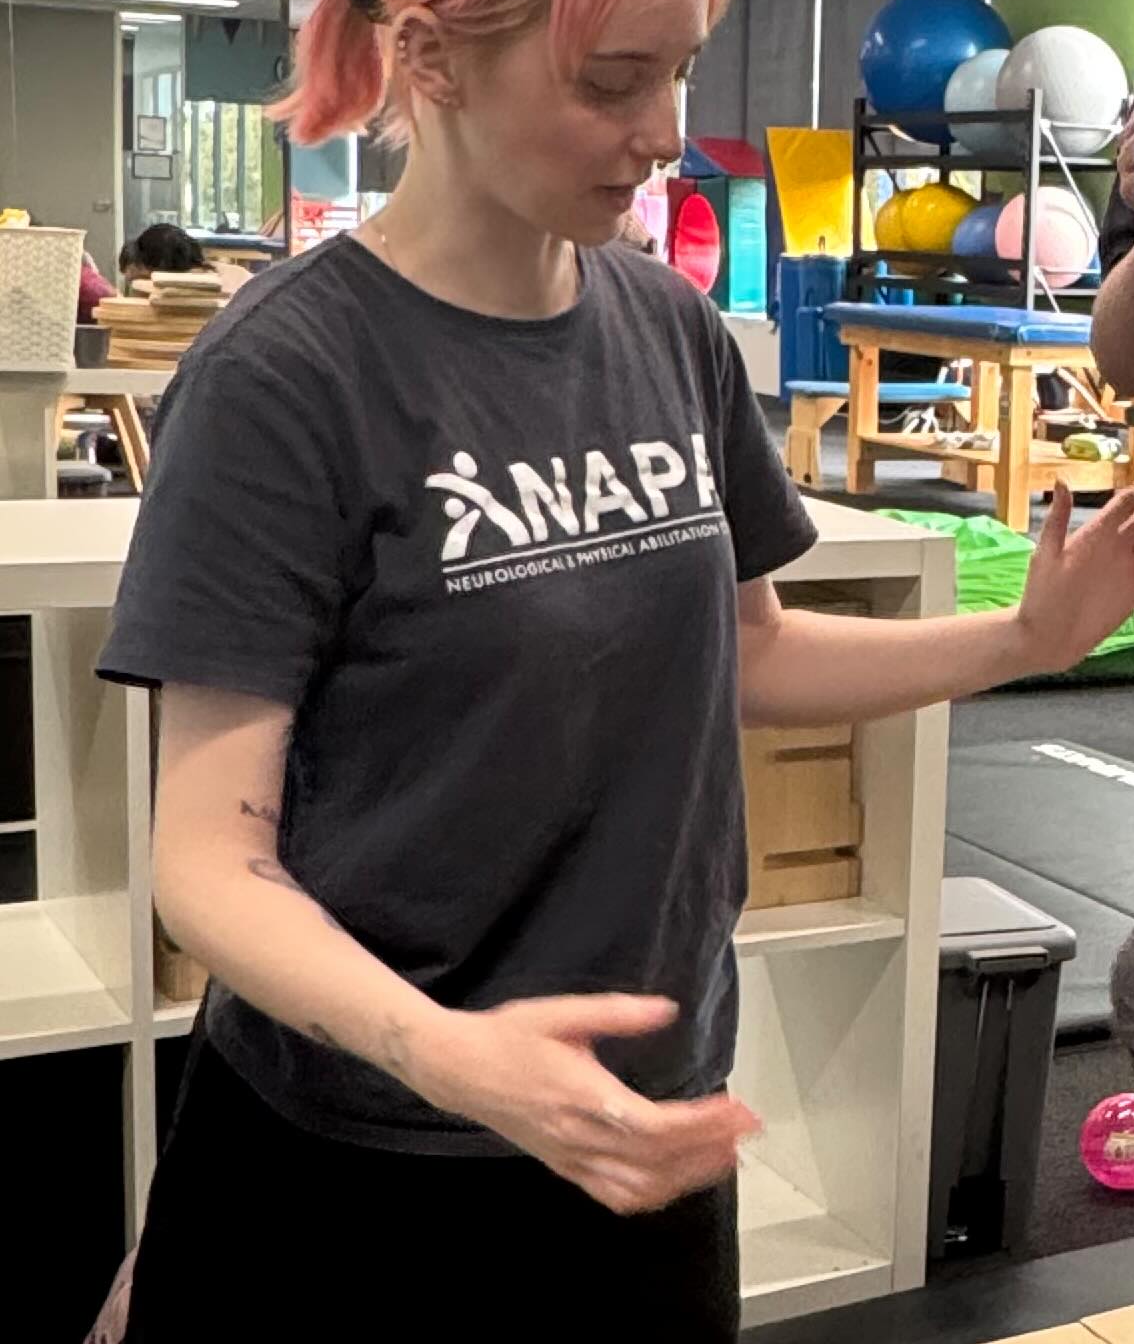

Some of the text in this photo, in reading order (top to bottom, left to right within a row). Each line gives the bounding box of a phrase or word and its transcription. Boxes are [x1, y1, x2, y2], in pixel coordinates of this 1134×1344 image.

[446, 554, 566, 595] NEUROLOGICAL
[576, 541, 637, 567] PHYSICAL
[638, 521, 719, 554] ABILITATION
